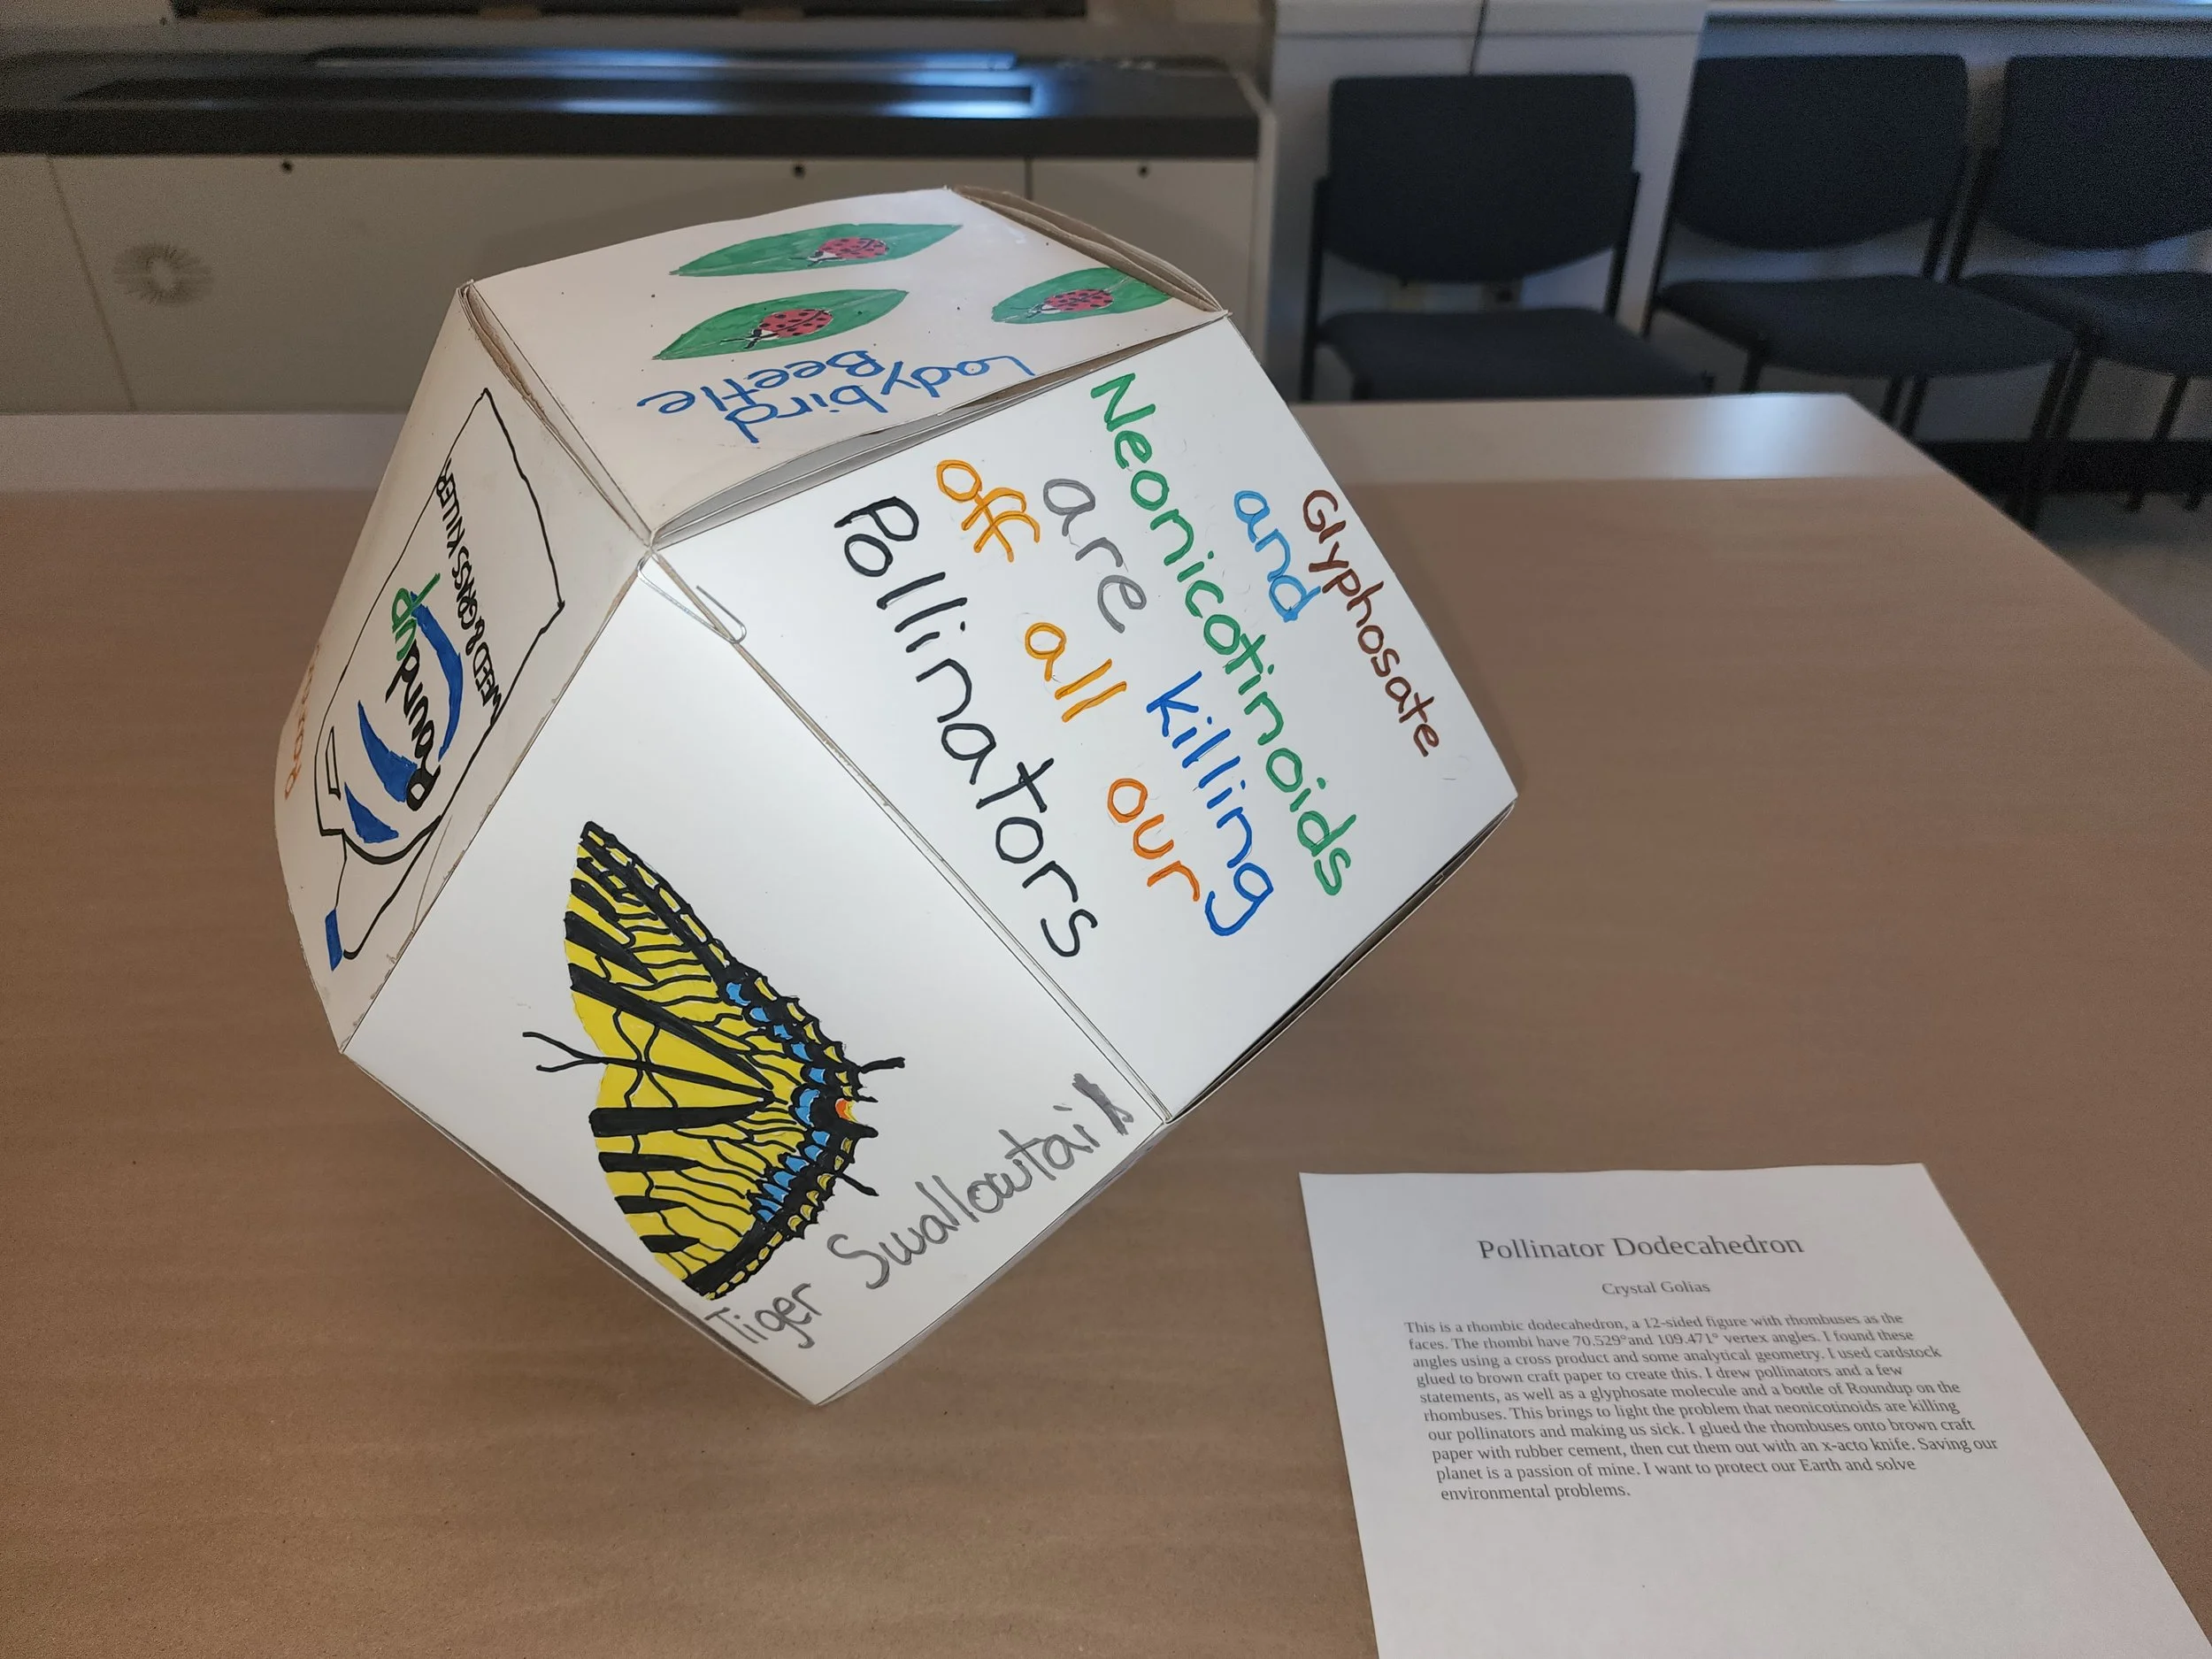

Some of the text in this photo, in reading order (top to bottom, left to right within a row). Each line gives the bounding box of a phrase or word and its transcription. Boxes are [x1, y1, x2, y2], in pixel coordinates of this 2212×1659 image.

[637, 350, 886, 413] Beetle
[436, 457, 465, 558] KILLER
[1042, 478, 1147, 633] are
[1233, 490, 1321, 622] and
[452, 546, 478, 629] GRASS
[1090, 373, 1356, 895] Neonicotinoids
[1302, 489, 1440, 757] Glyphosate
[473, 642, 502, 726] WEED
[936, 460, 1201, 901] off all our
[834, 496, 1097, 956] Pollinators
[1478, 1234, 1804, 1258] Pollinator Dodecahedron
[1601, 1280, 1710, 1297] Crystal Golias
[704, 1283, 822, 1349] Tiger
[1404, 1321, 1435, 1333] This
[1440, 1322, 1451, 1333] is
[1467, 1320, 1524, 1332] rhombic
[1528, 1318, 1629, 1331] dodecahedron,
[1644, 1316, 1703, 1328] 12-sided
[1706, 1317, 1748, 1330] figure
[1750, 1315, 1783, 1326] with
[1784, 1314, 1861, 1326] rhombuses
[1880, 1312, 1903, 1324] the
[1409, 1339, 1448, 1349] faces.
[1451, 1338, 1479, 1349] The
[1483, 1336, 1533, 1348] rhombi
[1536, 1335, 1570, 1347] have
[1724, 1334, 1769, 1343] vertex
[1772, 1331, 1820, 1345] angles.
[1822, 1331, 1832, 1341] I
[1833, 1330, 1876, 1341] found
[1877, 1329, 1914, 1341] these
[1413, 1355, 1457, 1370] angles
[1461, 1355, 1501, 1369] using
[1516, 1356, 1551, 1365] cross
[1555, 1352, 1609, 1367] product
[1613, 1351, 1639, 1363] and
[1642, 1354, 1679, 1363] some
[1684, 1348, 1751, 1364] analytical
[1755, 1350, 1824, 1363] geometry.
[1826, 1348, 1836, 1359] I
[1837, 1347, 1871, 1359] used
[1874, 1346, 1942, 1358] cardstock
[1417, 1372, 1455, 1388] glued
[1459, 1375, 1473, 1385] to
[1476, 1371, 1524, 1384] brown
[1527, 1370, 1560, 1382] craft
[1563, 1371, 1602, 1385] paper
[1606, 1371, 1621, 1380] to
[1625, 1371, 1667, 1380] create
[1671, 1367, 1702, 1379] this.
[1705, 1367, 1712, 1379] I
[1716, 1366, 1750, 1379] drew
[1755, 1365, 1832, 1381] pollinators
[1836, 1364, 1862, 1377] and
[1876, 1364, 1902, 1376] few
[1420, 1392, 1500, 1403] statements,
[1504, 1392, 1519, 1401] as
[1523, 1387, 1555, 1401] well
[1590, 1386, 1667, 1402] glyphosate
[1671, 1384, 1737, 1397] molecule
[1741, 1383, 1768, 1396] and
[1770, 1386, 1781, 1395] a
[1781, 1383, 1824, 1394] bottle
[1828, 1382, 1844, 1394] of
[1845, 1381, 1913, 1396] Roundup
[1916, 1385, 1936, 1394] on
[1937, 1380, 1961, 1394] the
[1425, 1399, 1961, 1422] rhombuses. This brings to light the problem that neonicotinoids are killing
[1428, 1417, 1976, 1443] our pollinators and making us sick. I glued the rhombuses onto brown craft
[1432, 1437, 1998, 1463] paper with rubber cement, then cut them out with an x-acto knife. Saving our
[1436, 1457, 1916, 1483] planet is a passion of mine. I want to protect our Earth and solve
[1441, 1483, 1631, 1500] environmental problems.
